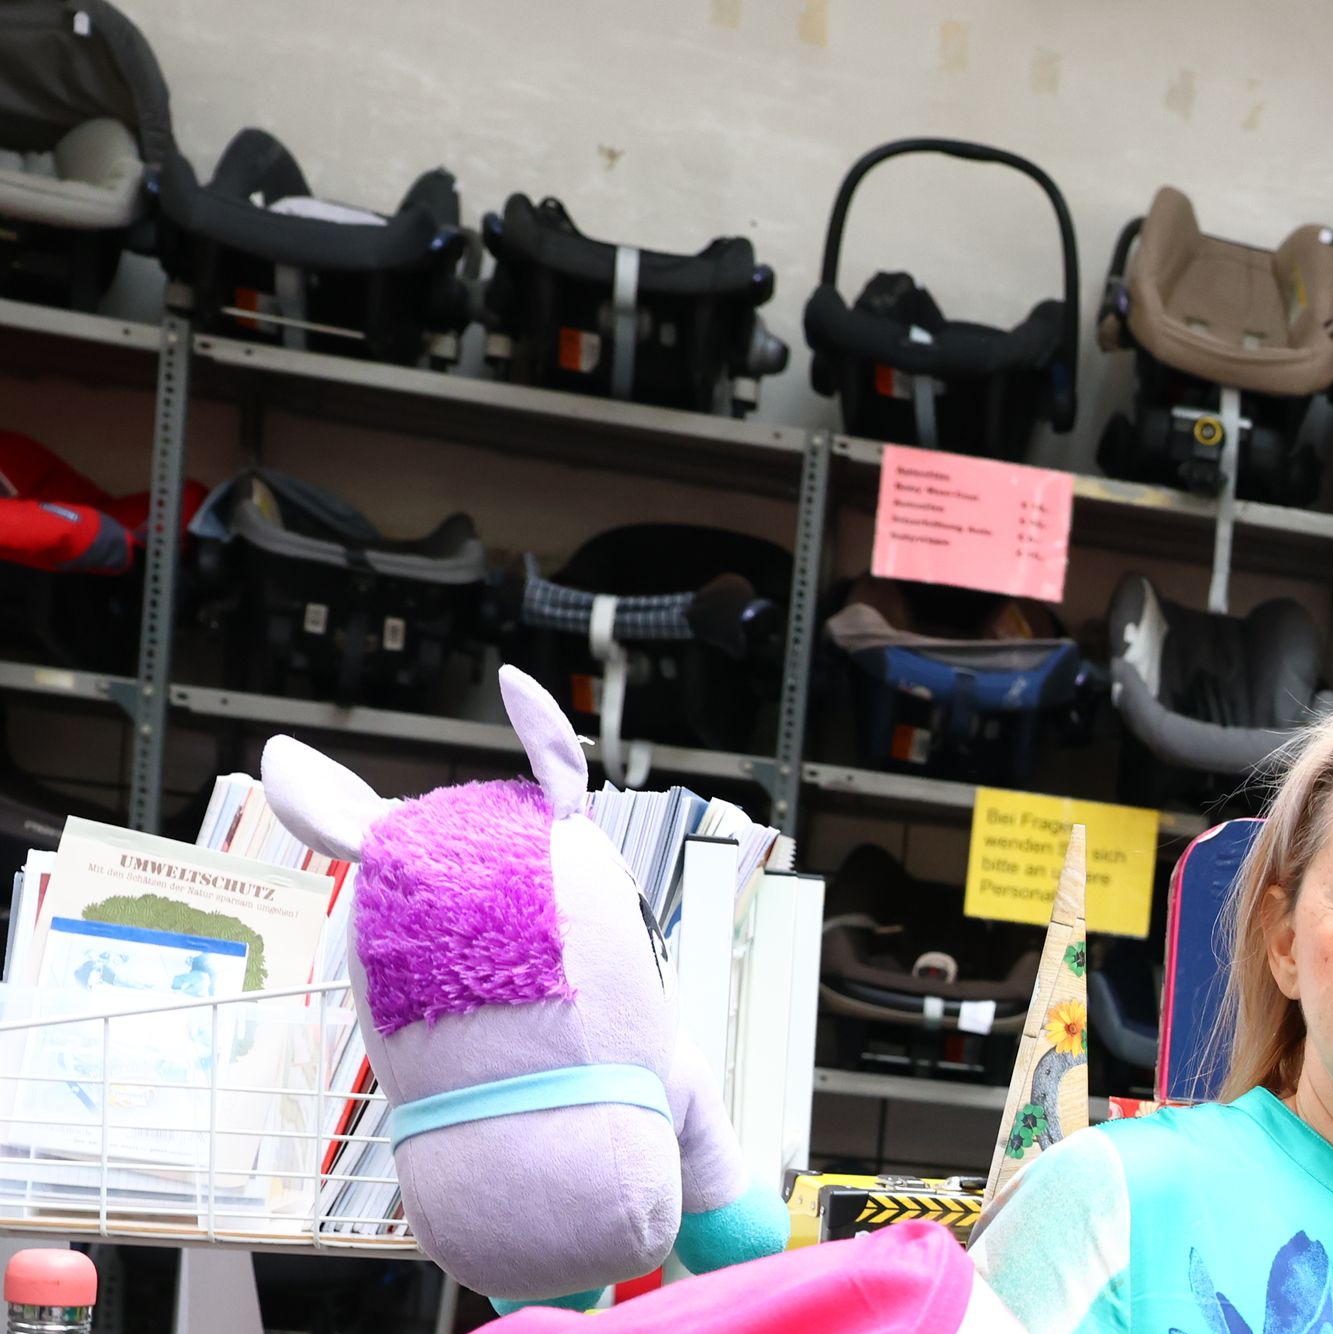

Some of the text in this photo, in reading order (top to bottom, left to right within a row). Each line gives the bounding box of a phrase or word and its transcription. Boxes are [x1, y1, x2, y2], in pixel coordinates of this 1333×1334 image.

[986, 808, 1073, 834] Bei Frage
[88, 863, 104, 875] Mit
[107, 867, 124, 878] den
[170, 881, 185, 893] der
[187, 886, 214, 899] Natur
[120, 854, 276, 902] UMWELTSCHUTZ
